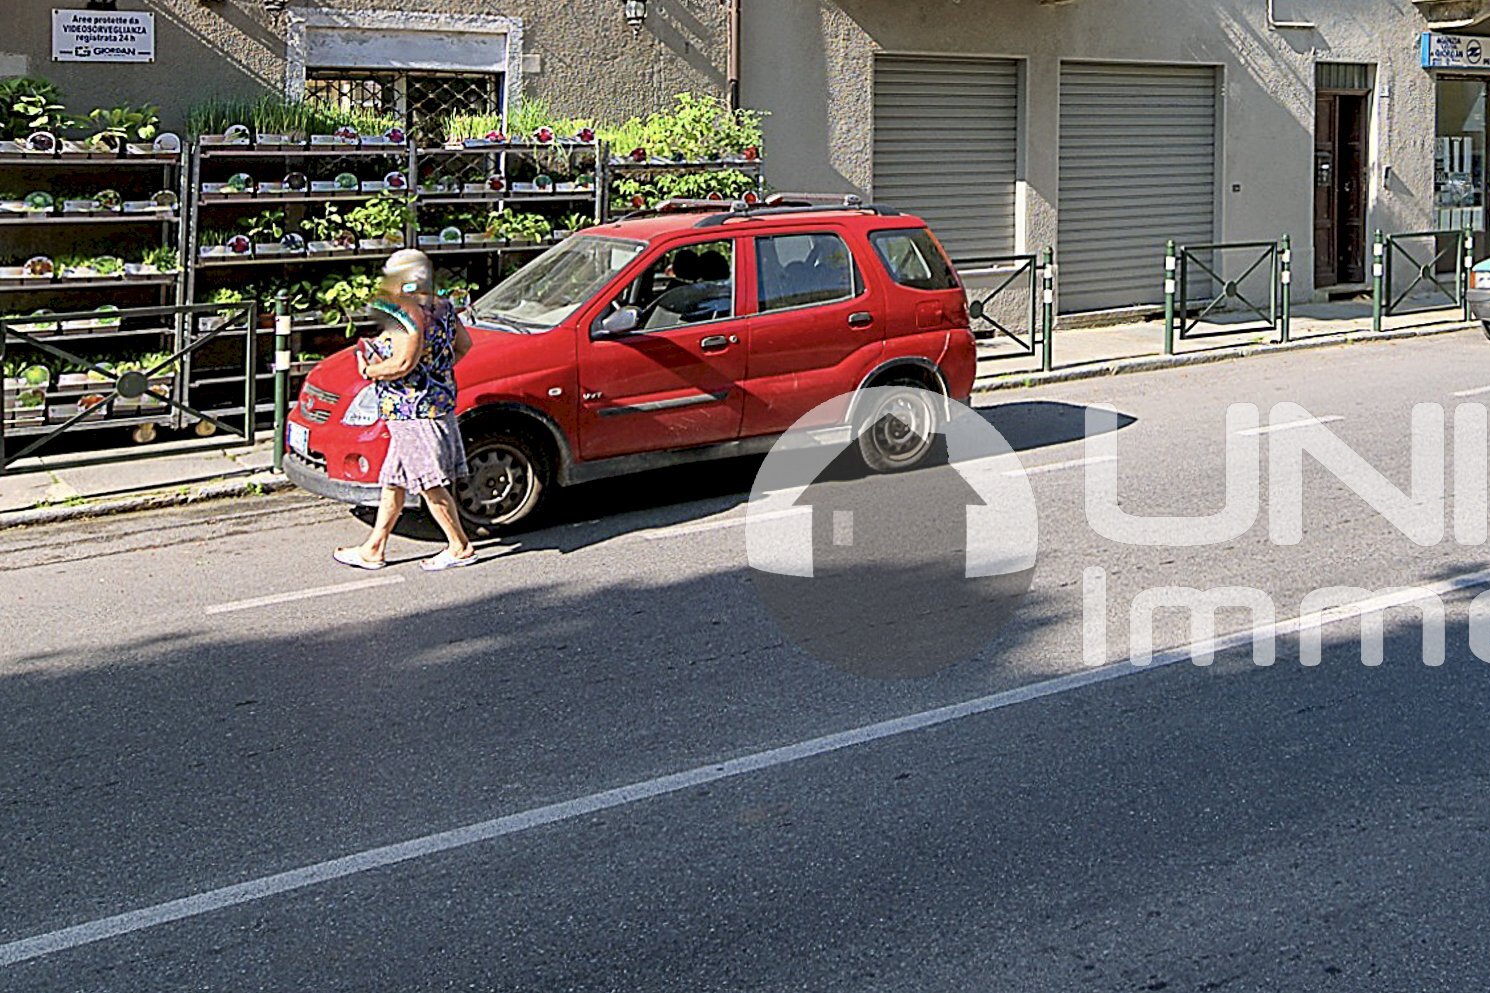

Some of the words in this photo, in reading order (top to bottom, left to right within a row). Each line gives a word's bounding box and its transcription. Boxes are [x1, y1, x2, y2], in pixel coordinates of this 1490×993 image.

[72, 15, 92, 24] Aree
[93, 17, 128, 25] protette
[129, 17, 140, 25] da
[63, 25, 147, 34] VIDEOSORVEGLIANZA
[75, 34, 118, 43] registrata
